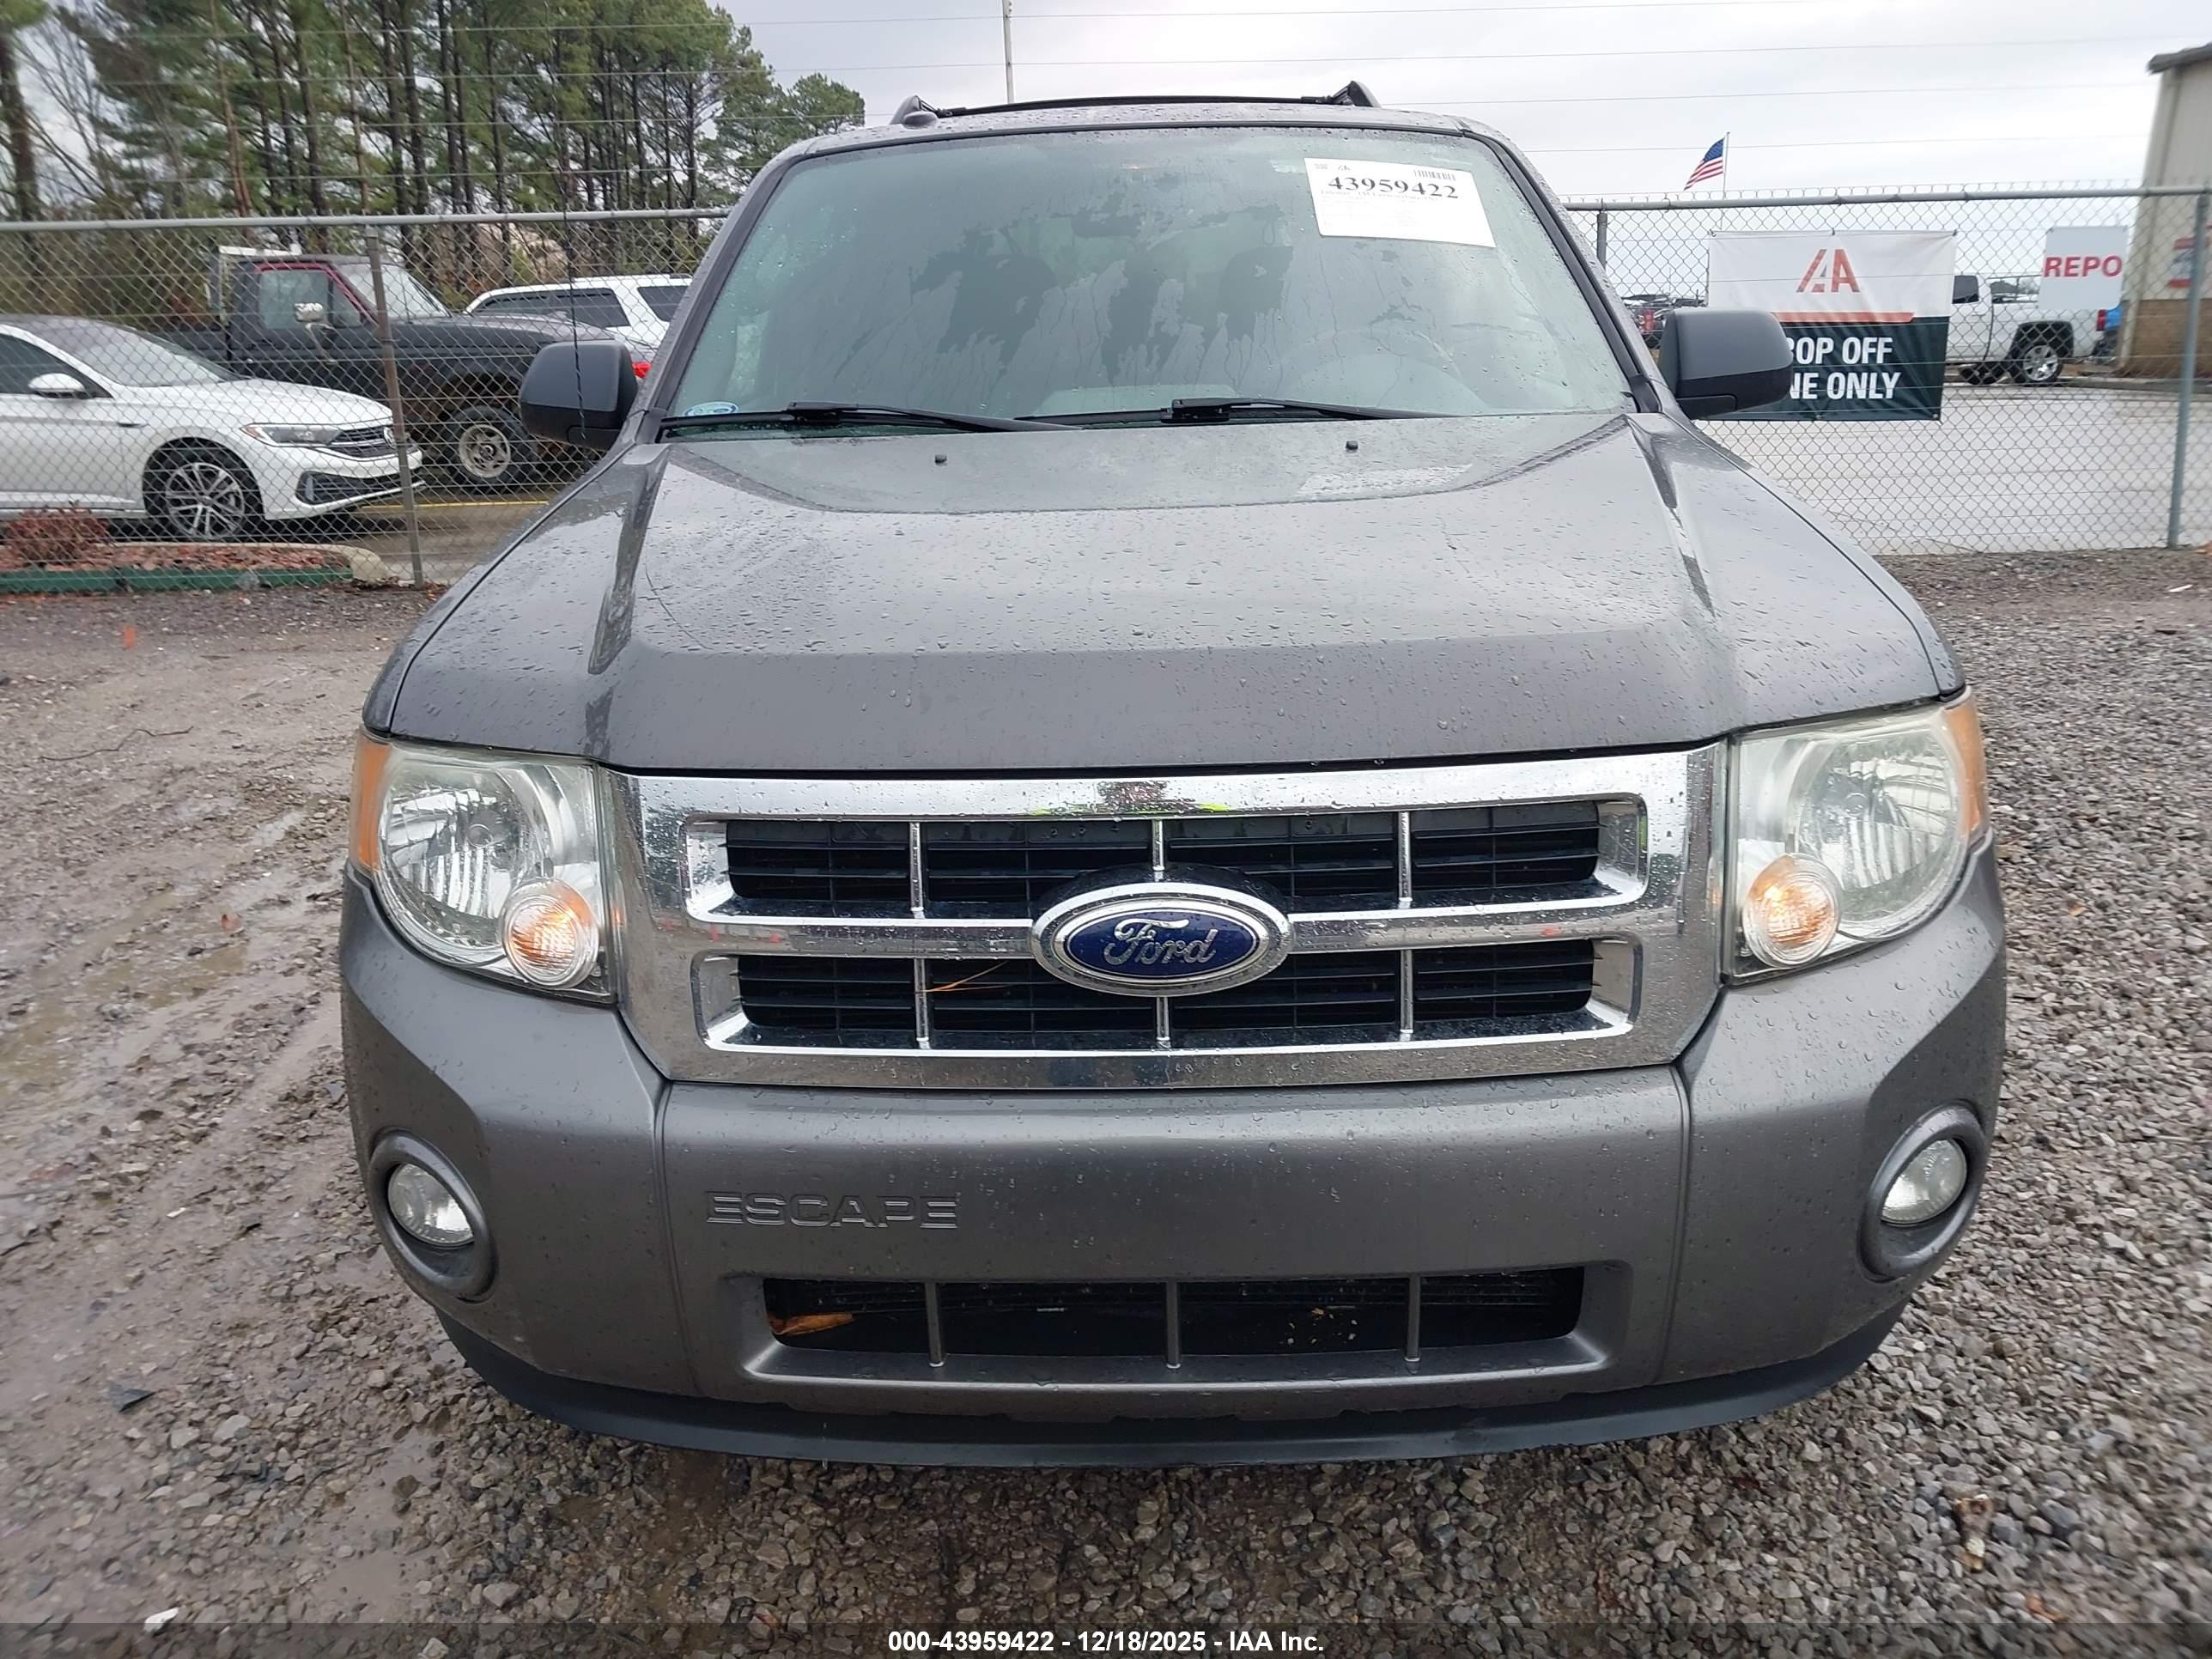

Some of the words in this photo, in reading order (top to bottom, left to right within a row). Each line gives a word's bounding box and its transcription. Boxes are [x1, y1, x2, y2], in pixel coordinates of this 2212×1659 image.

[1328, 176, 1459, 199] 43959422
[2043, 255, 2124, 277] REPO
[1786, 336, 1835, 365] OP
[1842, 336, 1893, 365] OFF
[1790, 371, 1820, 399] NE
[1826, 371, 1902, 400] ONLY
[1103, 917, 1219, 966] Ford
[705, 1190, 958, 1229] ESCAPE
